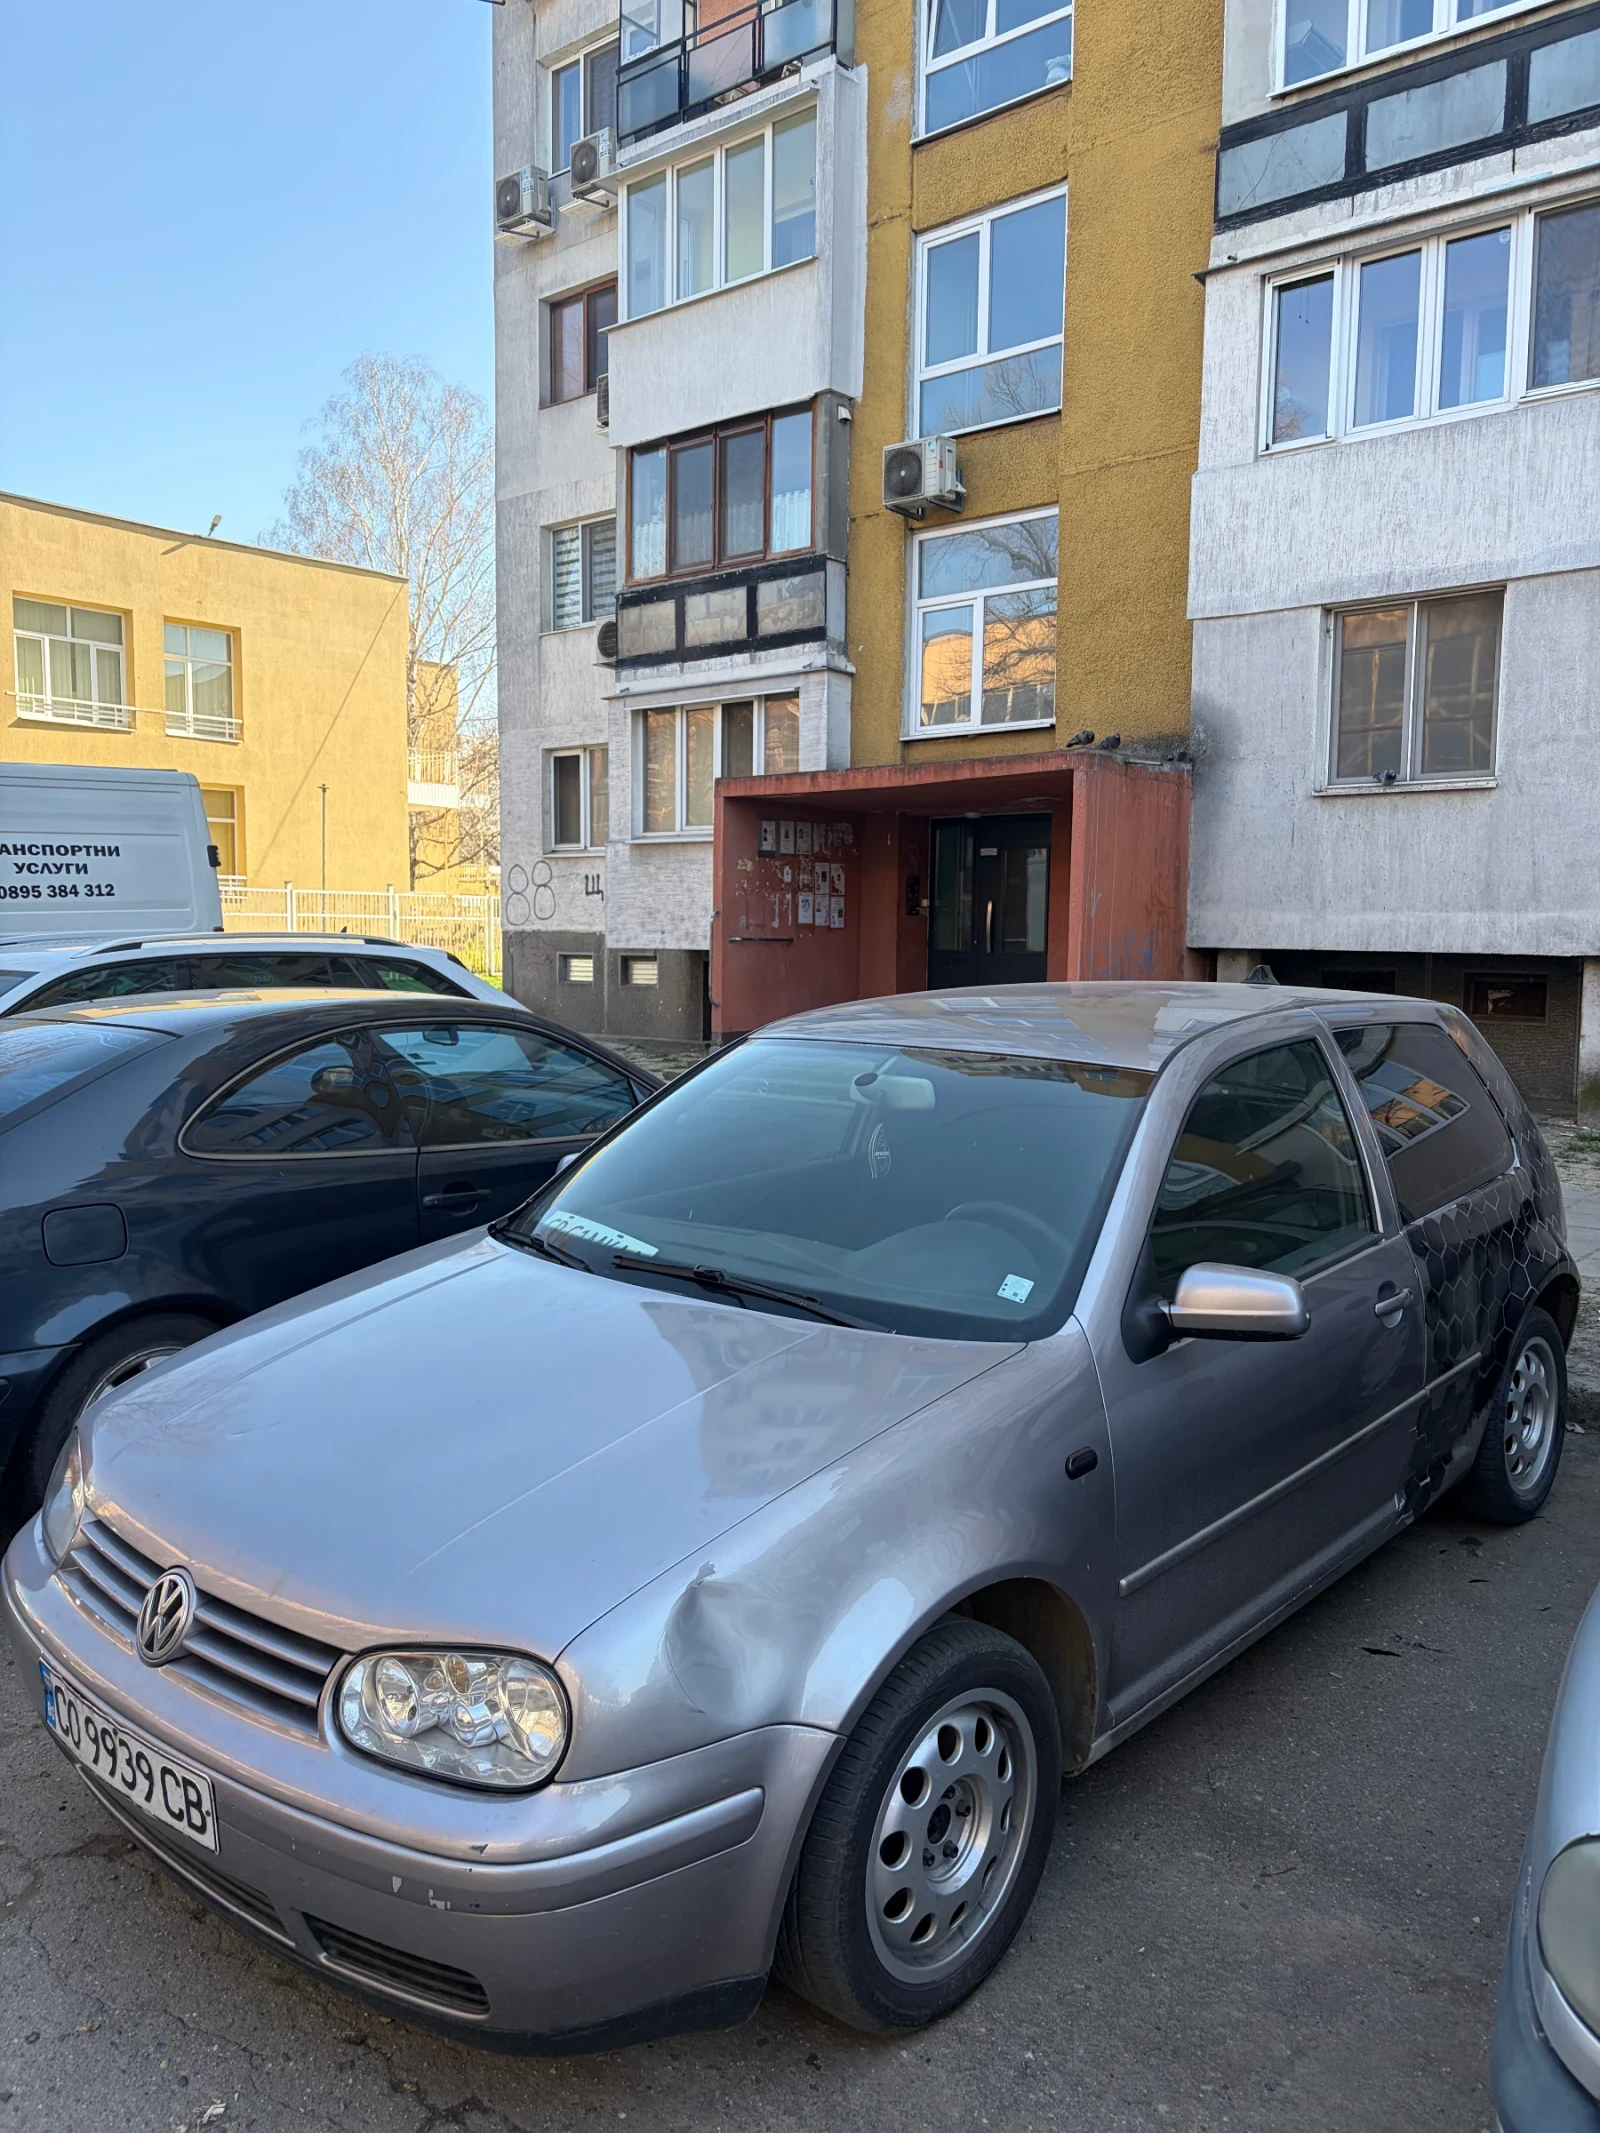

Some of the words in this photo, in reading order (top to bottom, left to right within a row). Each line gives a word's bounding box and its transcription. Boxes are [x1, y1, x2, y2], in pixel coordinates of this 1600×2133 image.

[12, 862, 88, 875] УСЛУГИ
[0, 885, 42, 900] 0895
[46, 884, 80, 898] 384
[84, 883, 115, 897] 312
[84, 1715, 155, 1804] 9939
